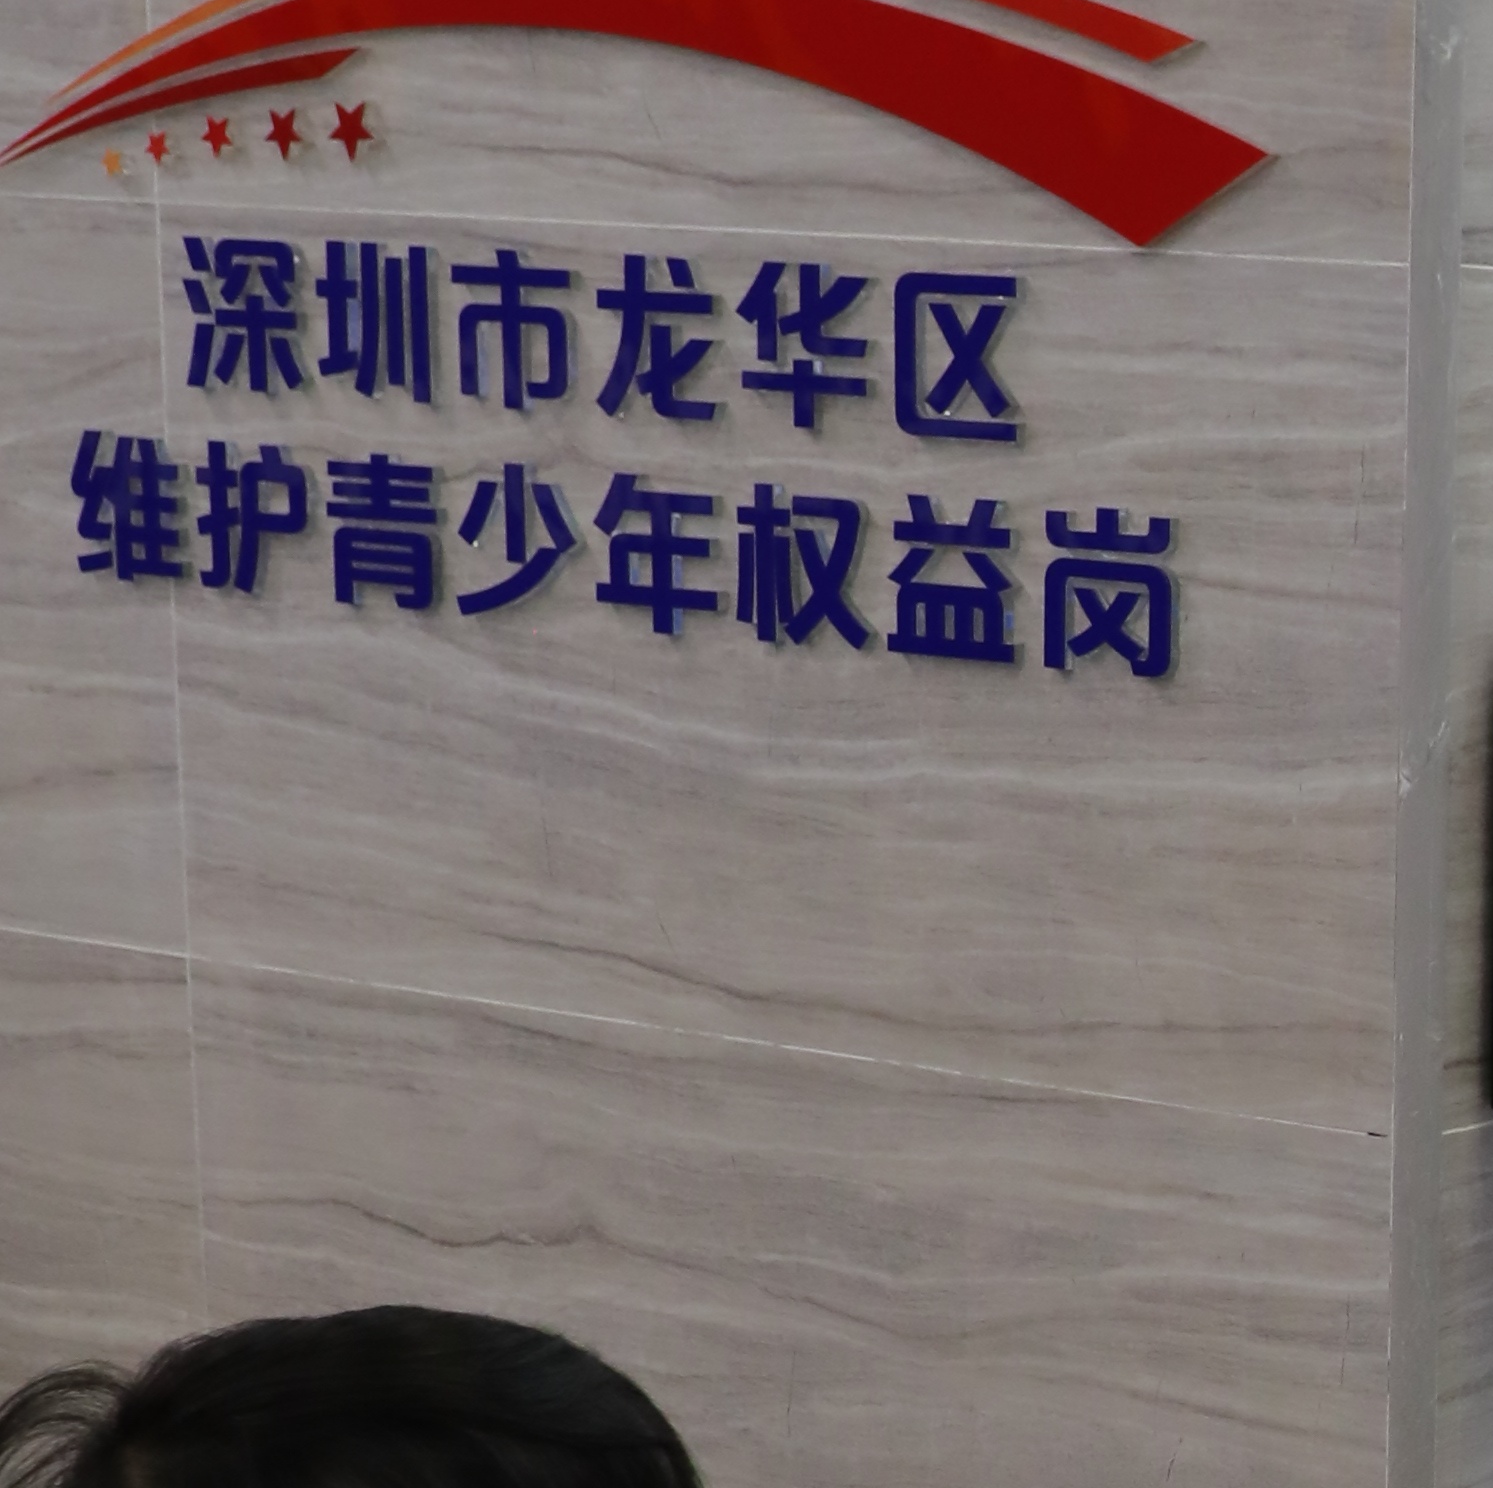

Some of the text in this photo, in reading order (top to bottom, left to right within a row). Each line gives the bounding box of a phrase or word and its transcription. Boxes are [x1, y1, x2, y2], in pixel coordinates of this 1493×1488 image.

[184, 237, 1019, 443] 深圳市龙华区
[70, 430, 1173, 678] 维护青少年权益岗
